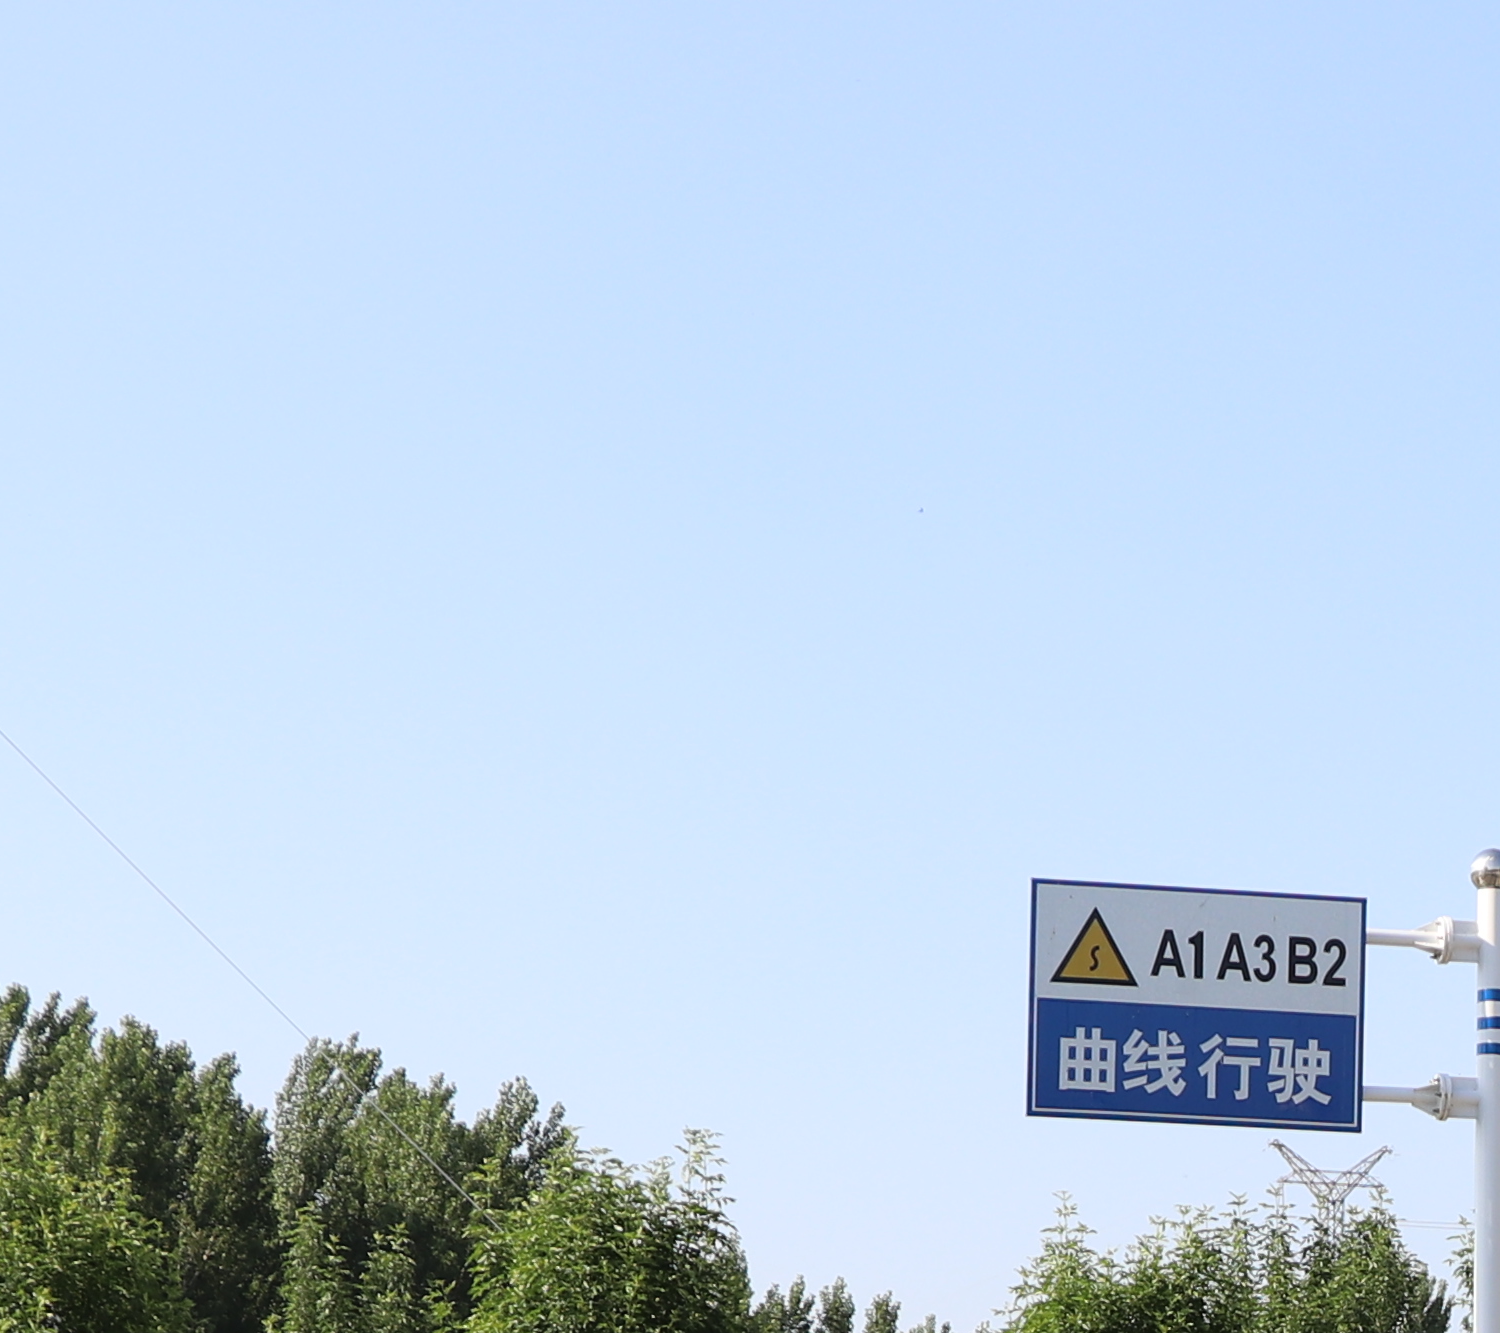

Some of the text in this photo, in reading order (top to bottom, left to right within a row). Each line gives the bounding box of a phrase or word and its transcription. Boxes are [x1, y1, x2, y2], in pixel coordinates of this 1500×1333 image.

[1150, 928, 1347, 987] A1A3B2
[1058, 1026, 1332, 1106] 曲线行驶
